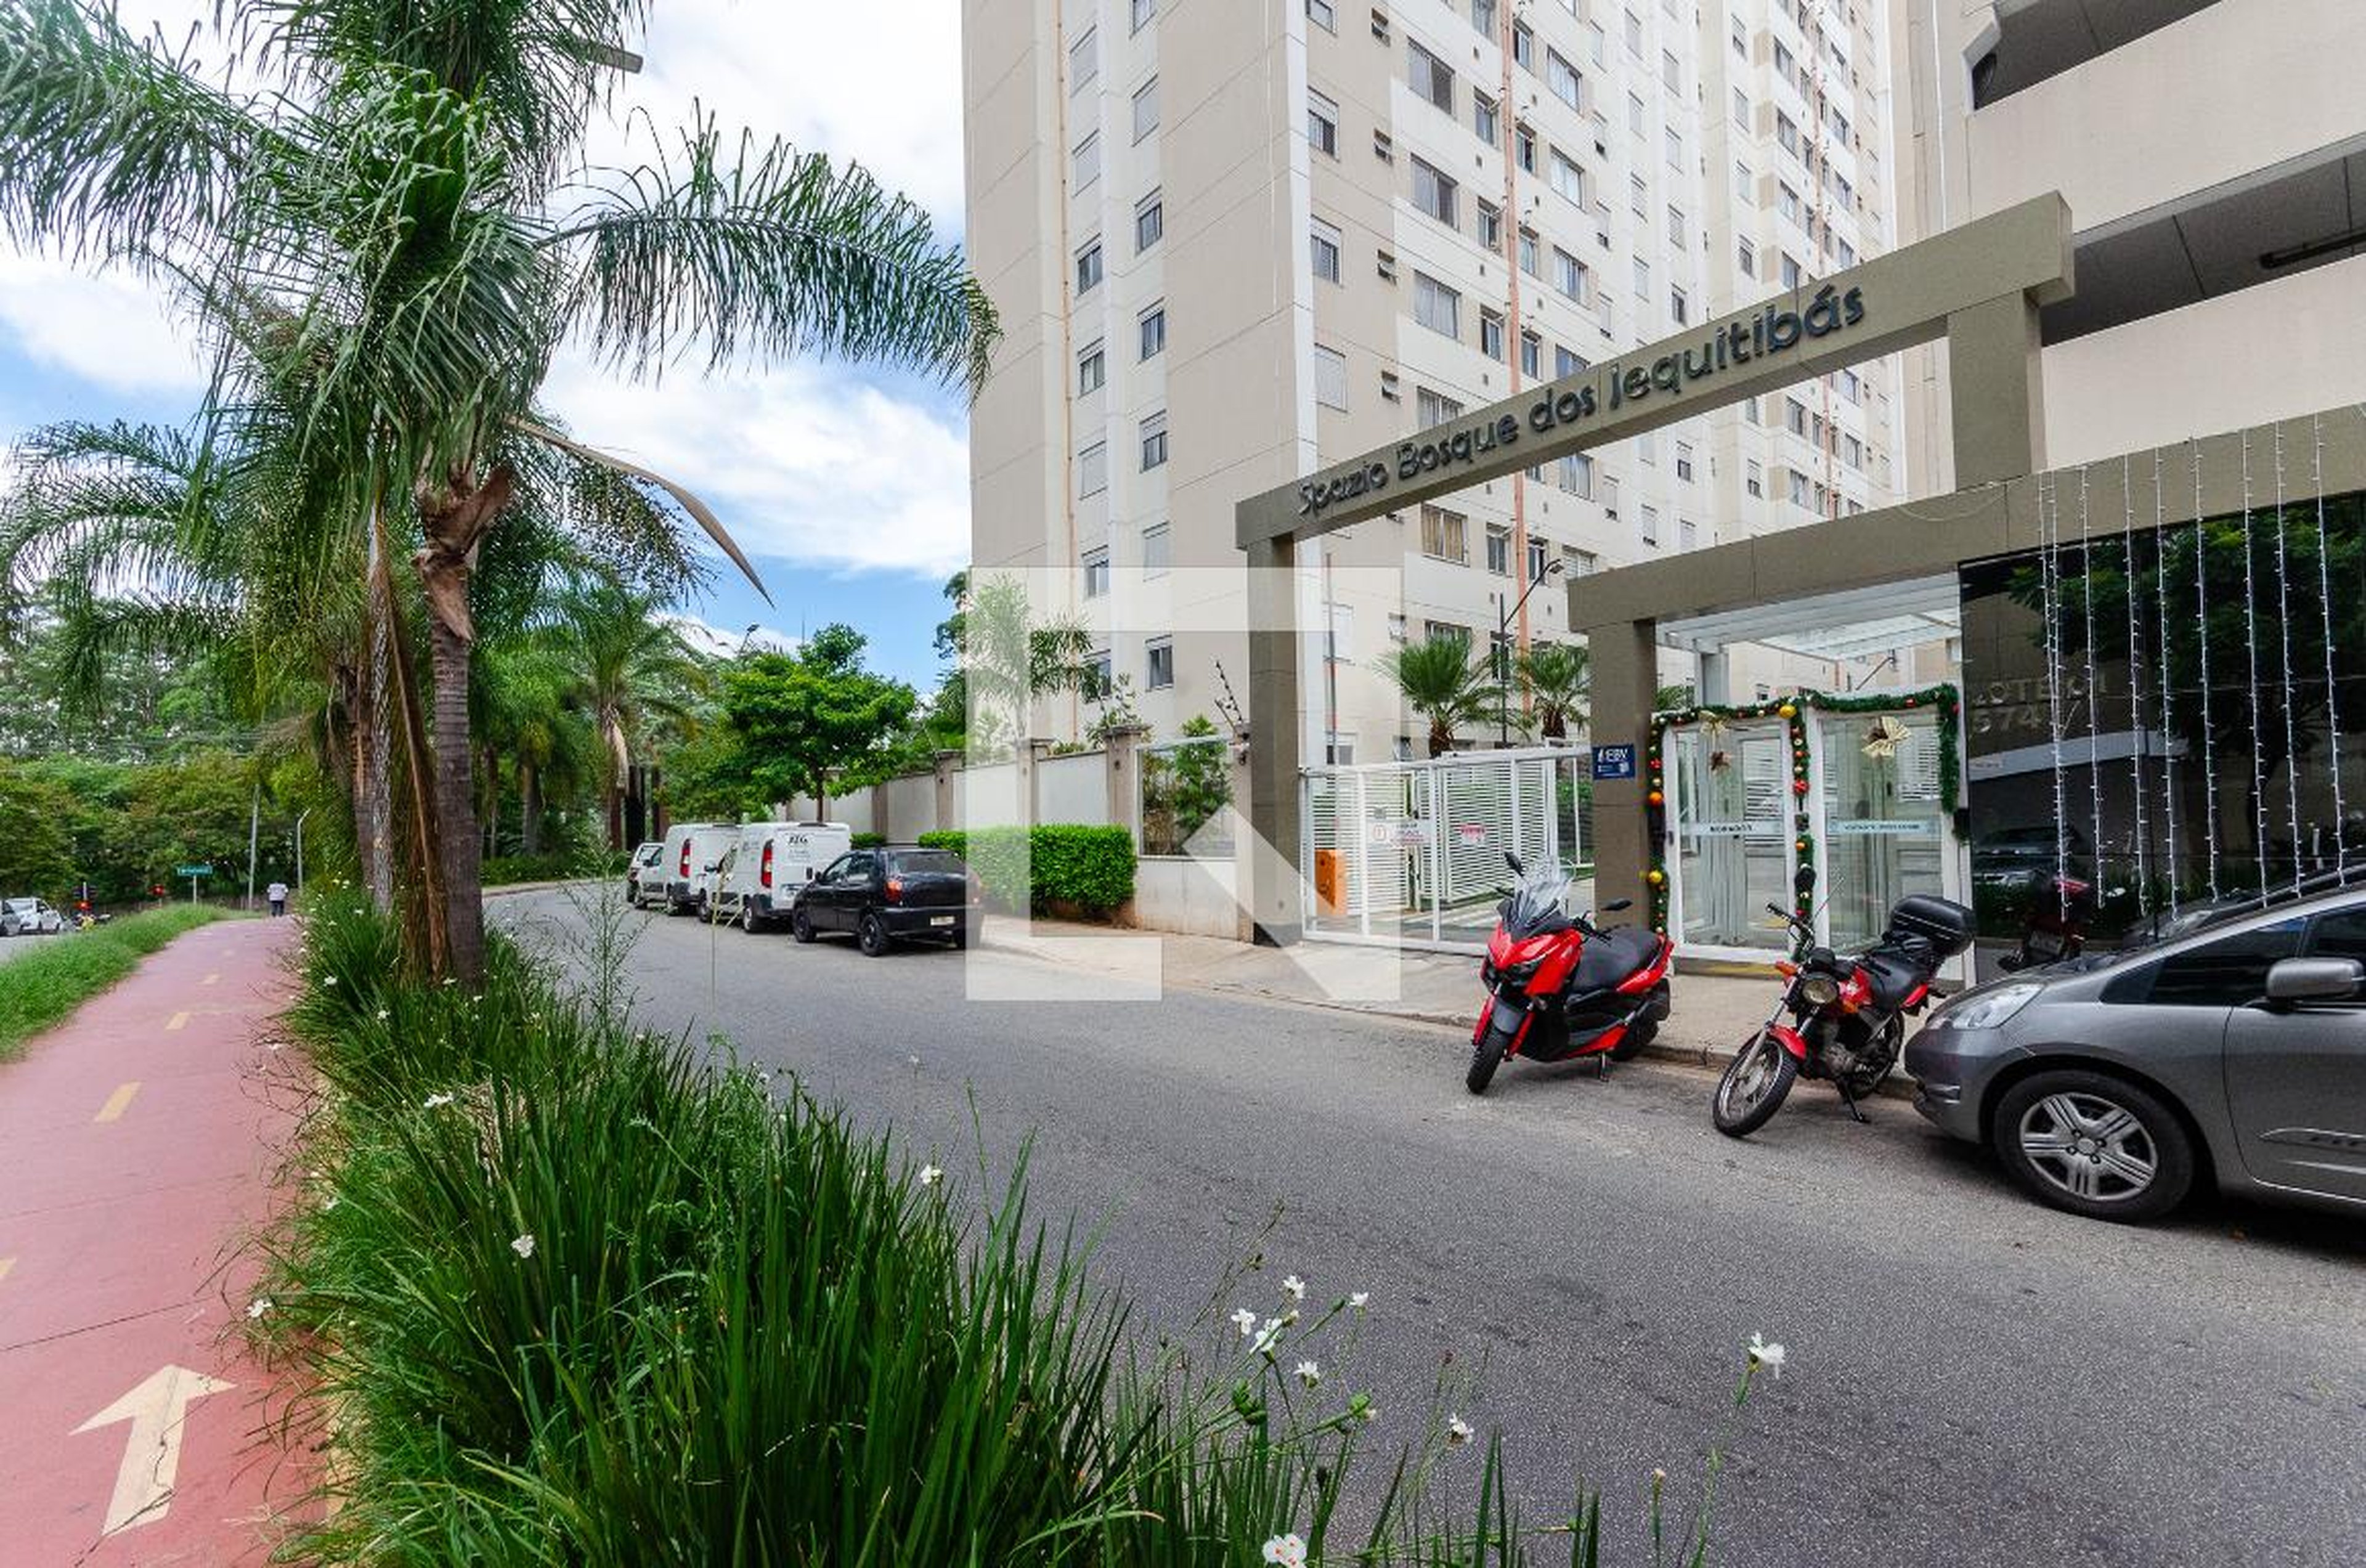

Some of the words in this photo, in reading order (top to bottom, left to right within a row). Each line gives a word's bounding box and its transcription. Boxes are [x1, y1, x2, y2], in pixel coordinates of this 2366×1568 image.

[1299, 461, 1389, 517] Spazio
[1396, 413, 1520, 481] Bosque
[1527, 383, 1597, 433] dos
[1609, 283, 1866, 411] Jequitibás
